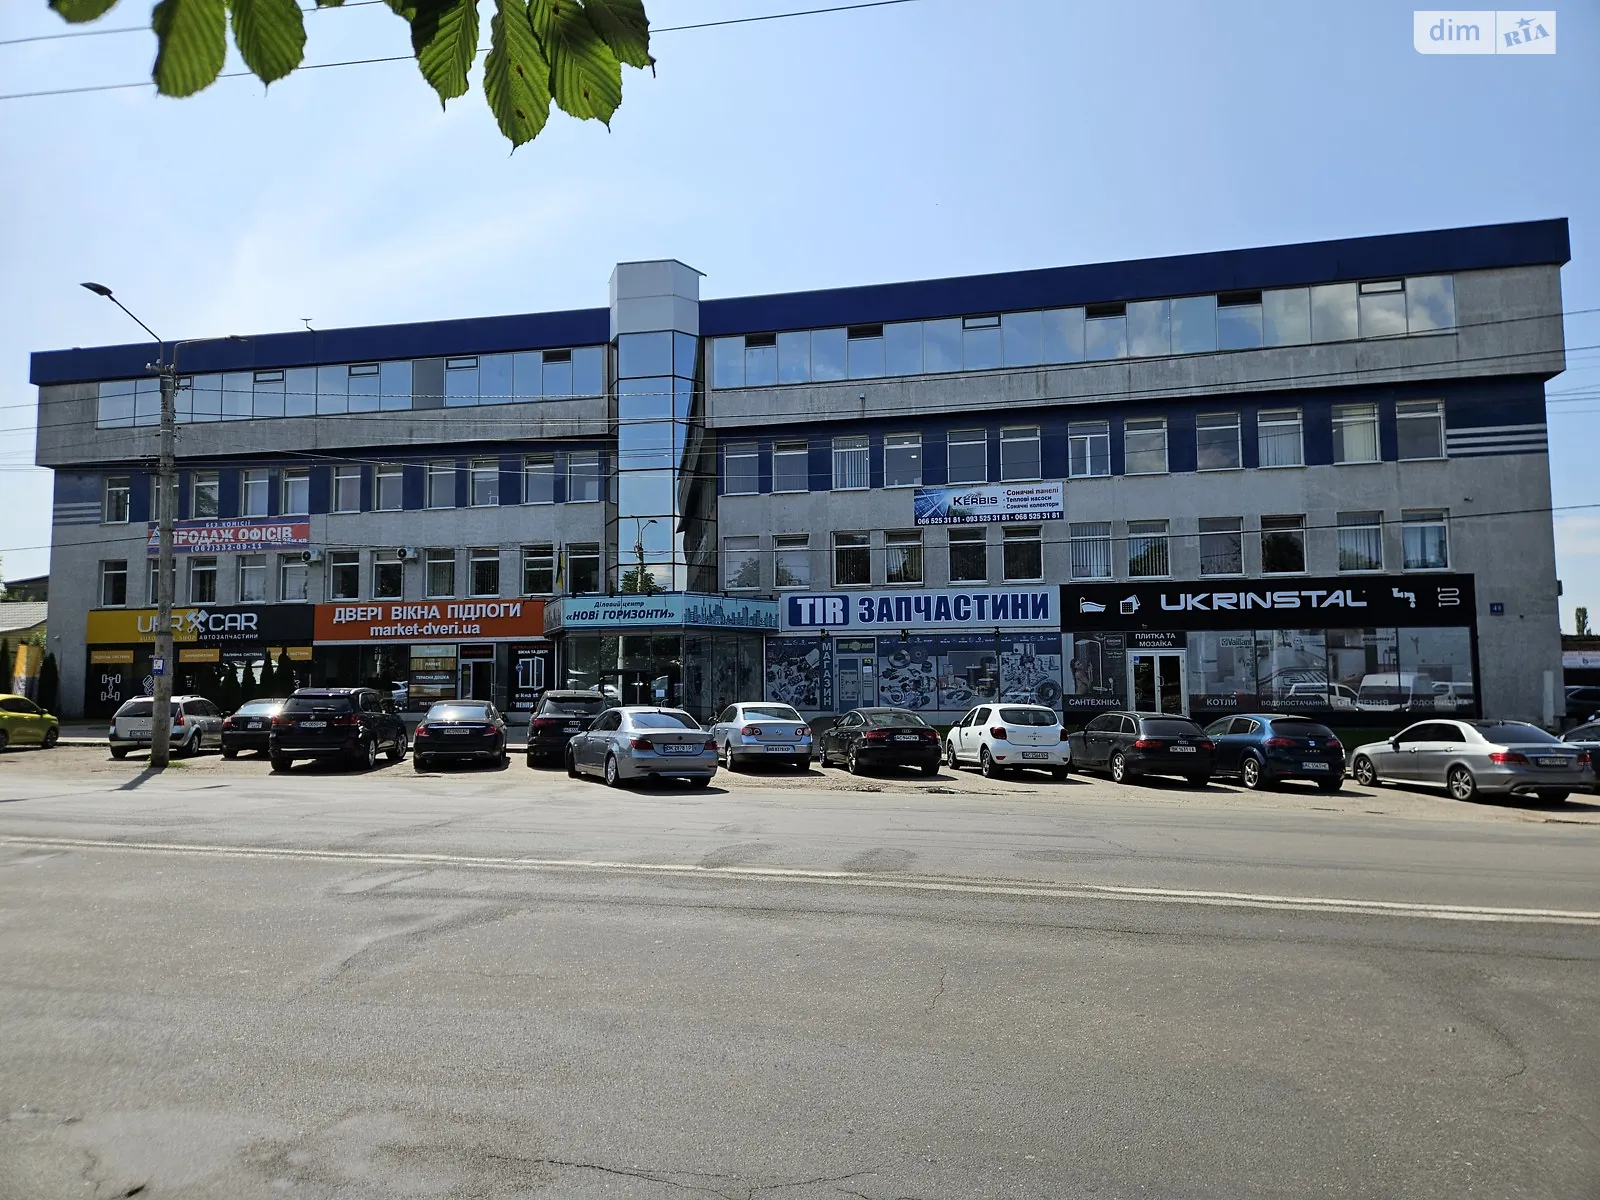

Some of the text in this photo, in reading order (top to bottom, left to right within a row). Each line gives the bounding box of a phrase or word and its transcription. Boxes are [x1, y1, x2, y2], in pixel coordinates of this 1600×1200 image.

[953, 496, 998, 506] KERBIS
[238, 526, 292, 541] ОФІСІВ
[1160, 589, 1368, 611] UKRINSTAL
[333, 602, 522, 624] ДВЕРІ ВІКНА ПІДЛОГИ
[602, 608, 675, 620] ГОРИЗОНТИ»
[796, 592, 1050, 625] TIR ЗАПЧАСТИНИ
[208, 612, 259, 632] CAR
[370, 622, 481, 636] market-dveri.ua
[822, 642, 832, 706] МАГАЗИН
[1069, 698, 1121, 706] САНТЕХНІКА
[1206, 698, 1238, 706] КОТЛИ
